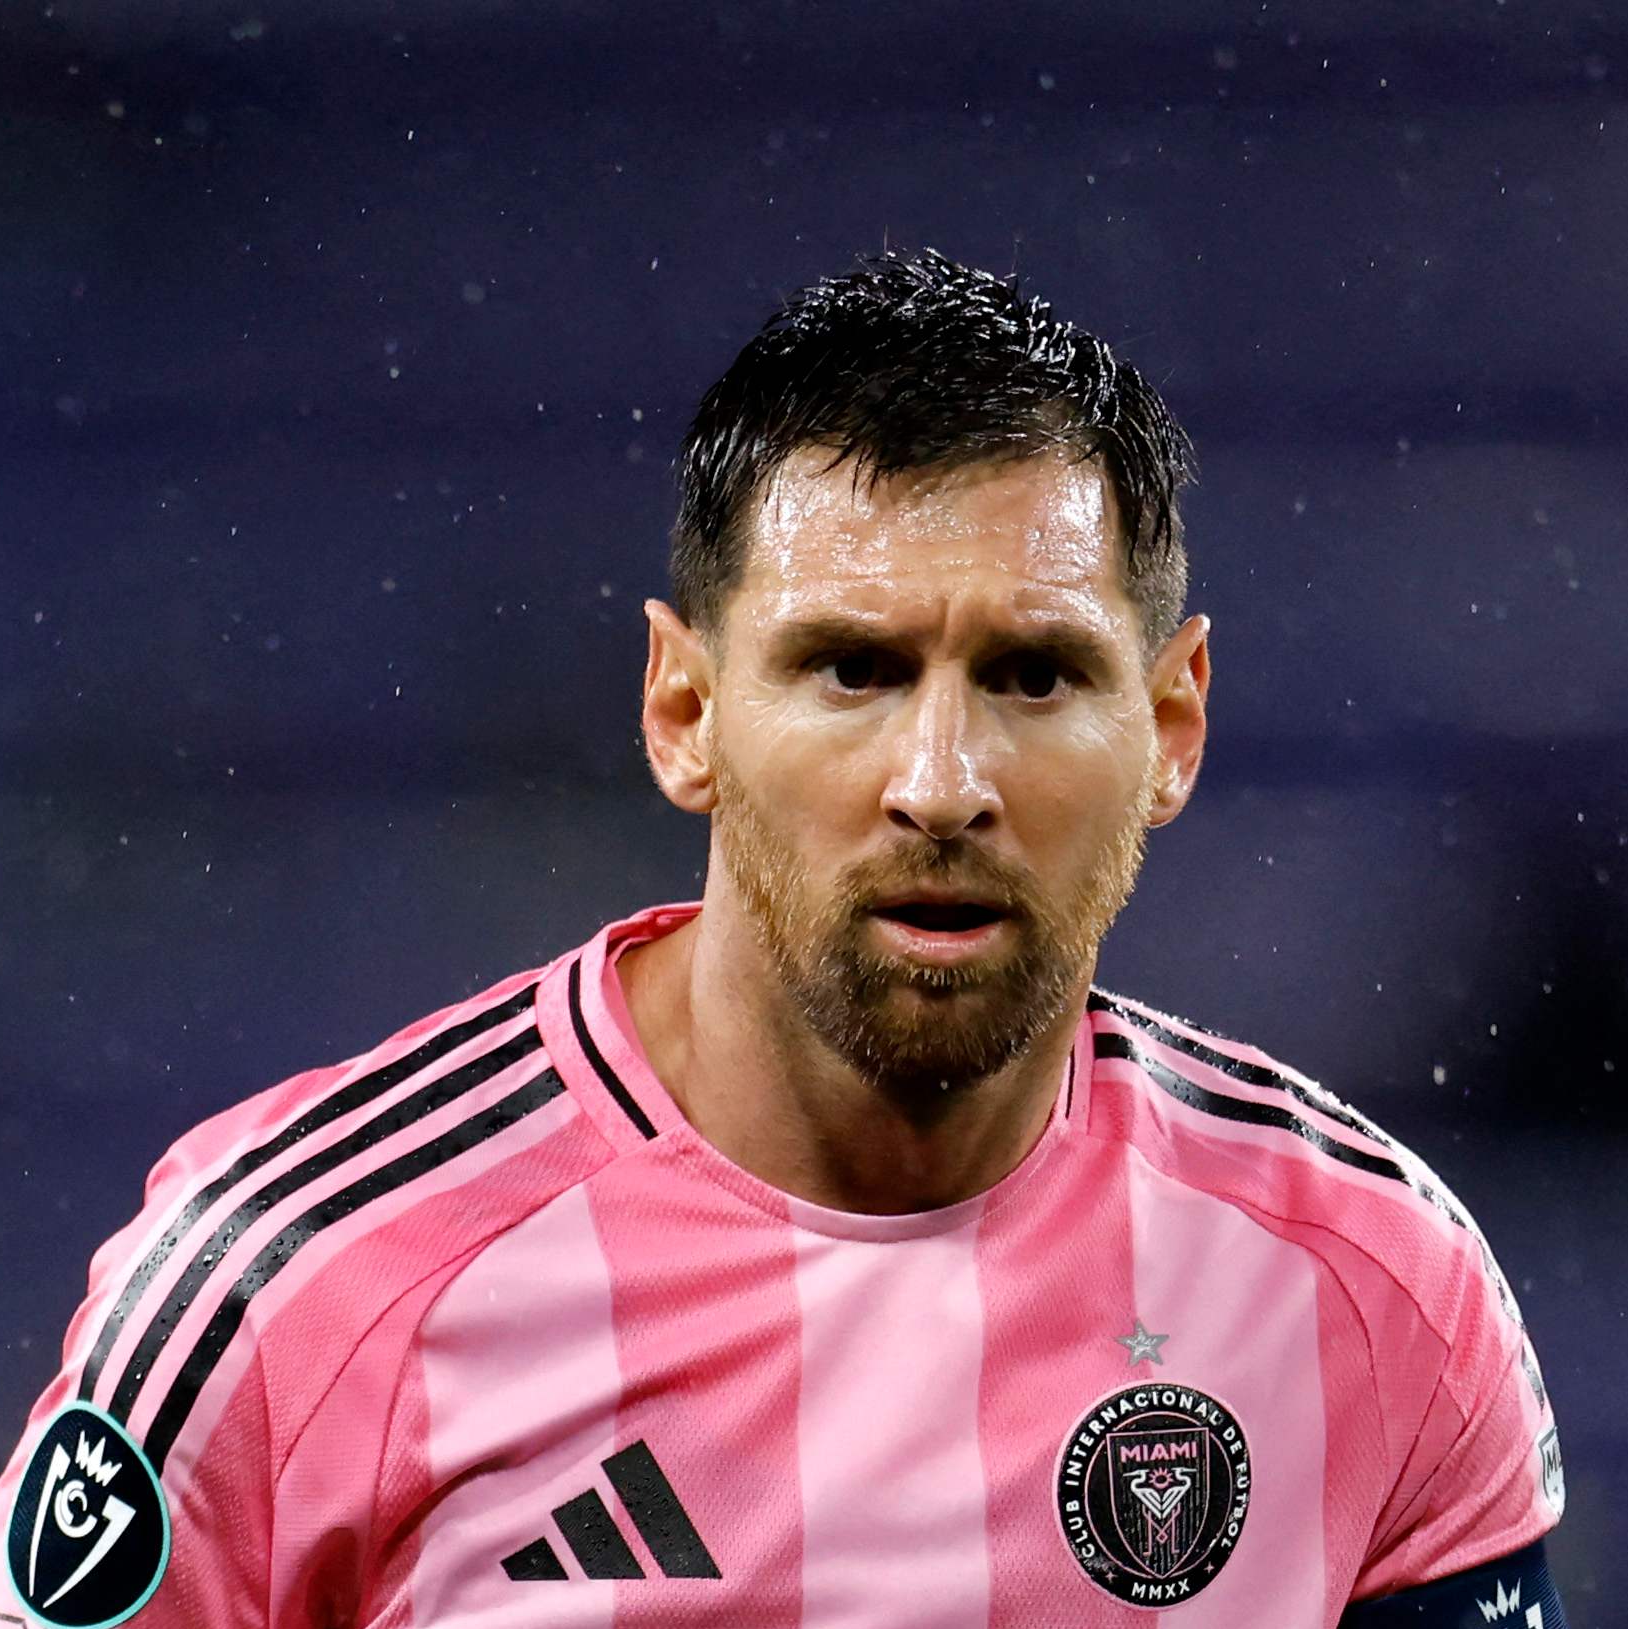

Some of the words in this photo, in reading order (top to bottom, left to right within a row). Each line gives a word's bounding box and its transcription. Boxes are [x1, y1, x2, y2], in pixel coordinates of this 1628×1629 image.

[1065, 1391, 1220, 1486] INTERNACIONAL
[1121, 1441, 1197, 1463] MIAMI
[1223, 1425, 1243, 1455] DE
[1066, 1499, 1095, 1558] CLUB
[1131, 1578, 1191, 1600] MMXX
